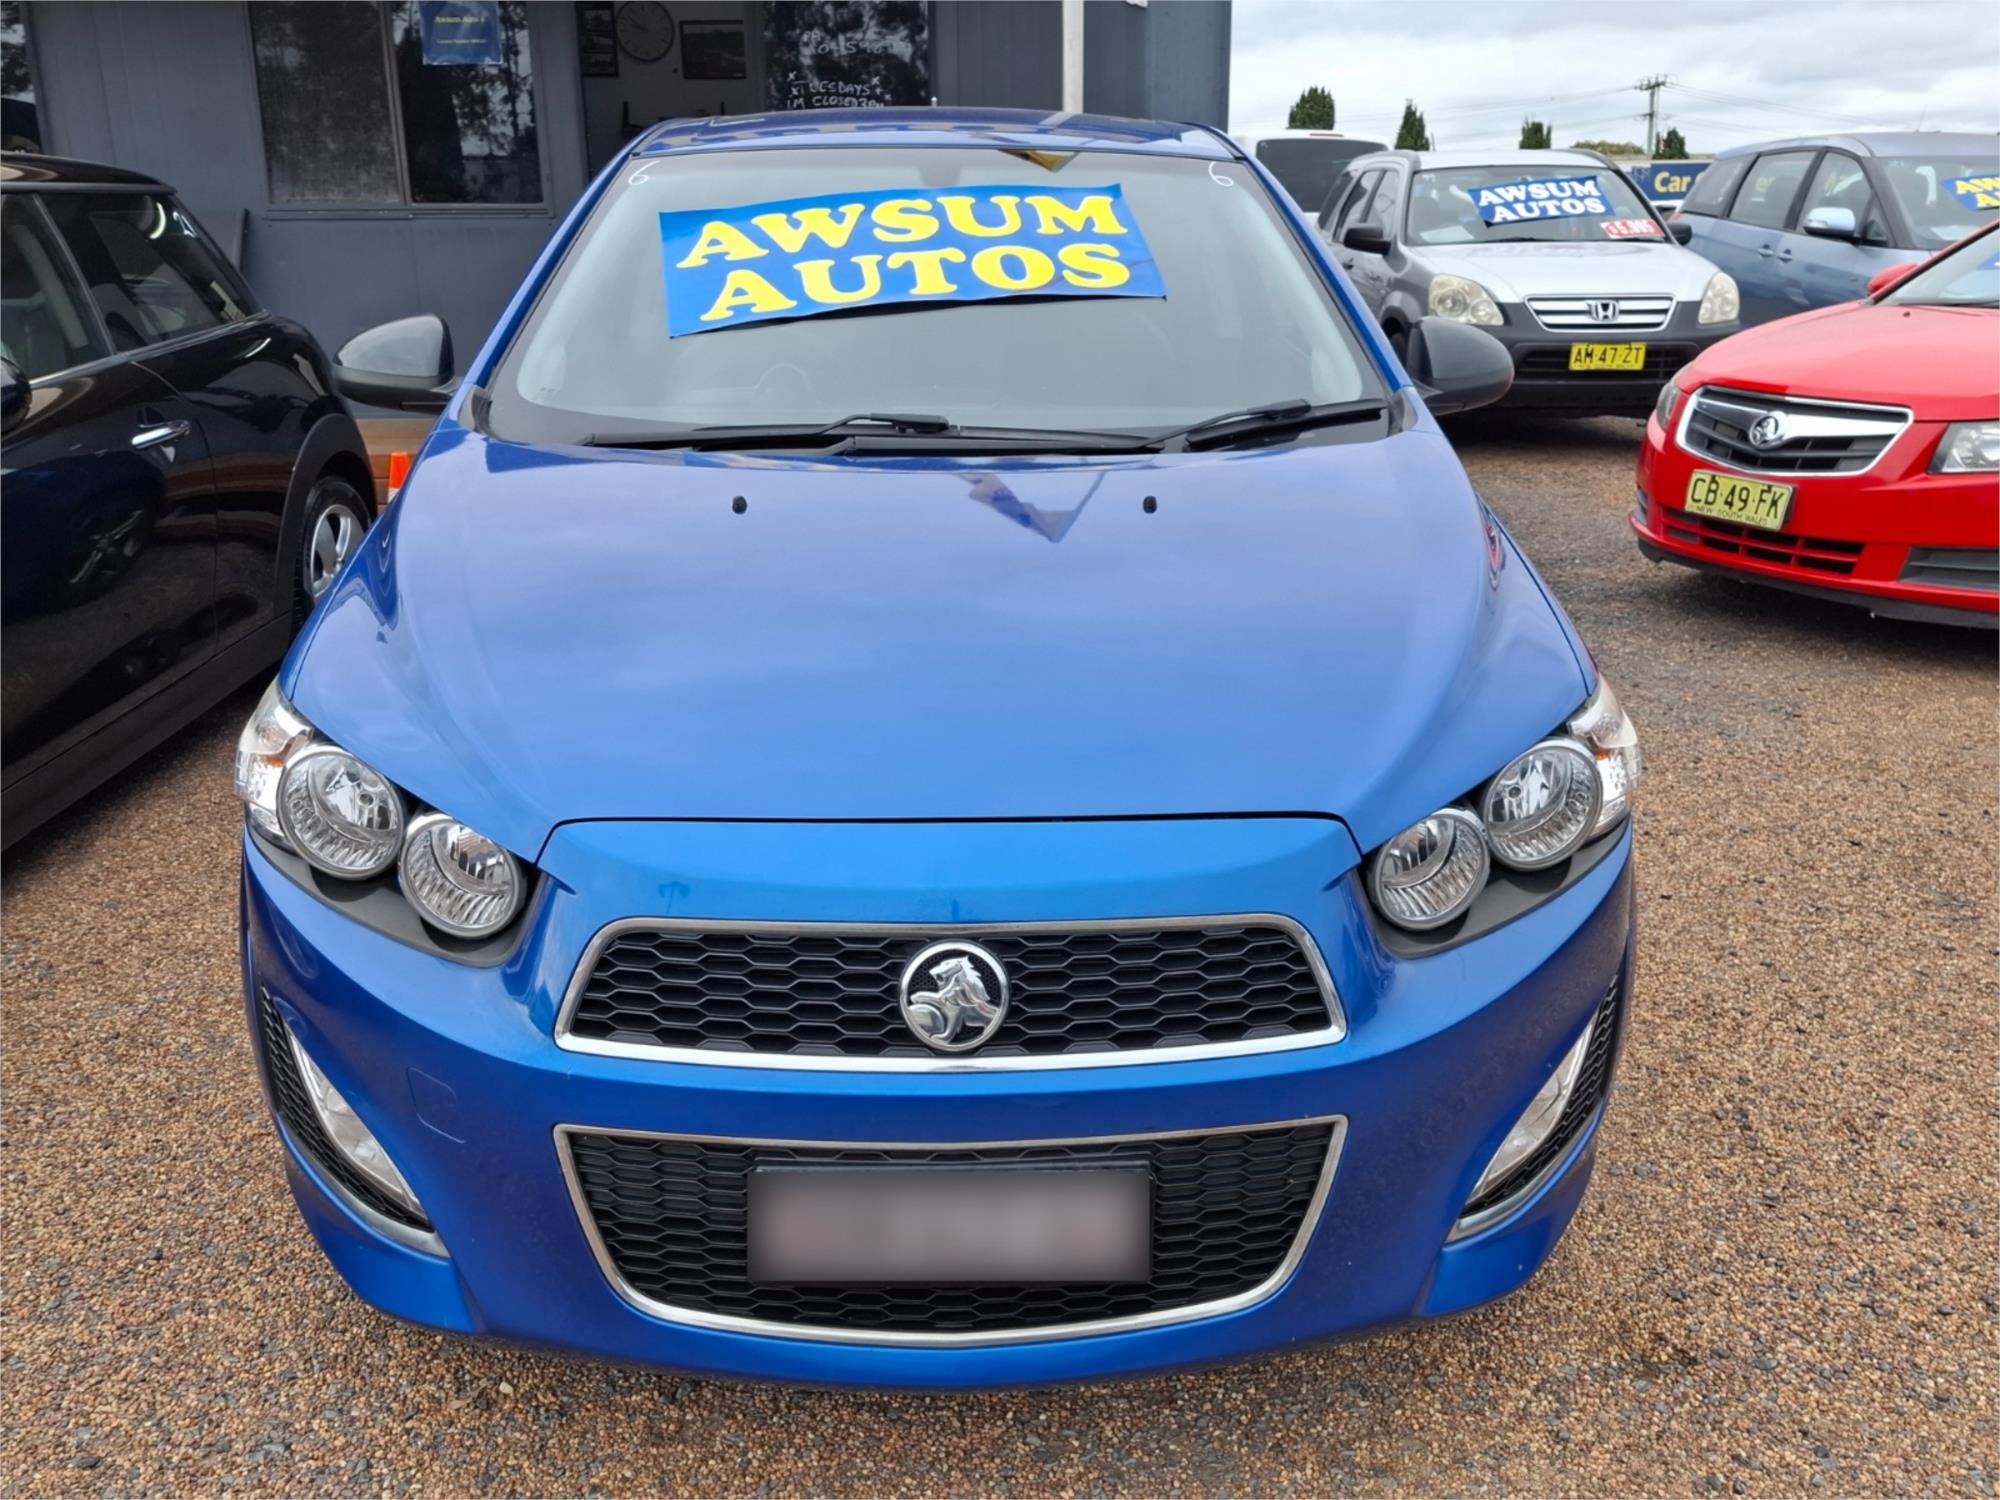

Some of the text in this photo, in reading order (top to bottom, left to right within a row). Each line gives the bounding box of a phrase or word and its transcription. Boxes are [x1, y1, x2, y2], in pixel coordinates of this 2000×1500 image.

[1479, 180, 1601, 207] AWSUM
[1654, 171, 1691, 192] Car
[1492, 197, 1606, 223] AUTOS
[676, 195, 1128, 268] AWSUM
[700, 243, 1130, 320] AUTOS
